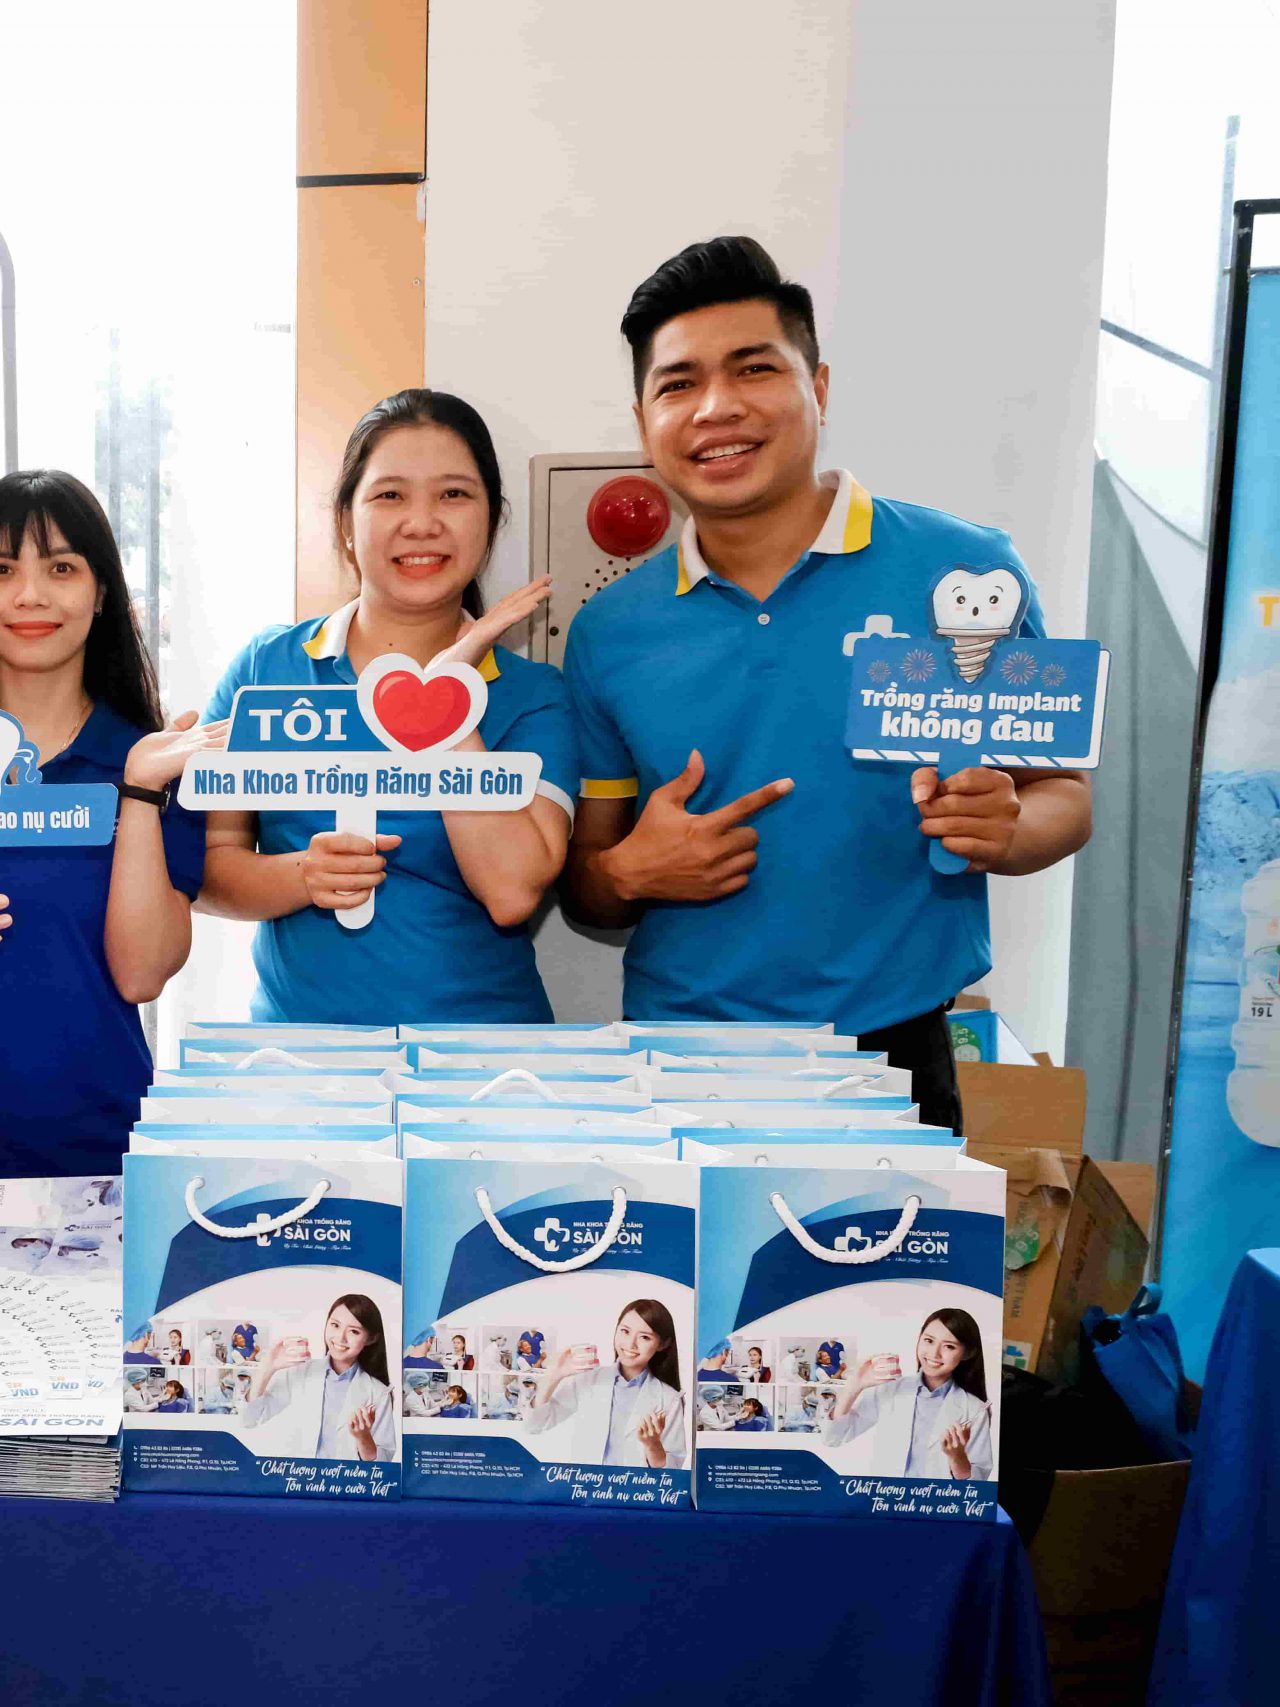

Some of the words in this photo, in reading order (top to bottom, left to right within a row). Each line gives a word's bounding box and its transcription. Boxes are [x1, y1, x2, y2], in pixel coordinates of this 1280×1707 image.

[930, 687, 983, 713] răng
[988, 691, 1083, 714] Implant
[248, 697, 348, 743] TÔI
[880, 710, 982, 745] không
[990, 713, 1055, 742] đau
[194, 769, 236, 795] Nha
[243, 769, 298, 795] Khoa
[305, 763, 369, 798] Trồng
[375, 765, 431, 798] Răng
[438, 765, 473, 796] Sài
[480, 765, 523, 796] Gòn
[22, 810, 45, 834] nụ
[50, 805, 91, 829] cười
[1251, 1007, 1264, 1017] 19
[1266, 1007, 1273, 1017] L
[284, 1225, 309, 1240] SÀI
[314, 1225, 351, 1242] GÒN
[573, 1228, 600, 1244] SÀI
[907, 1237, 949, 1255] GÒN
